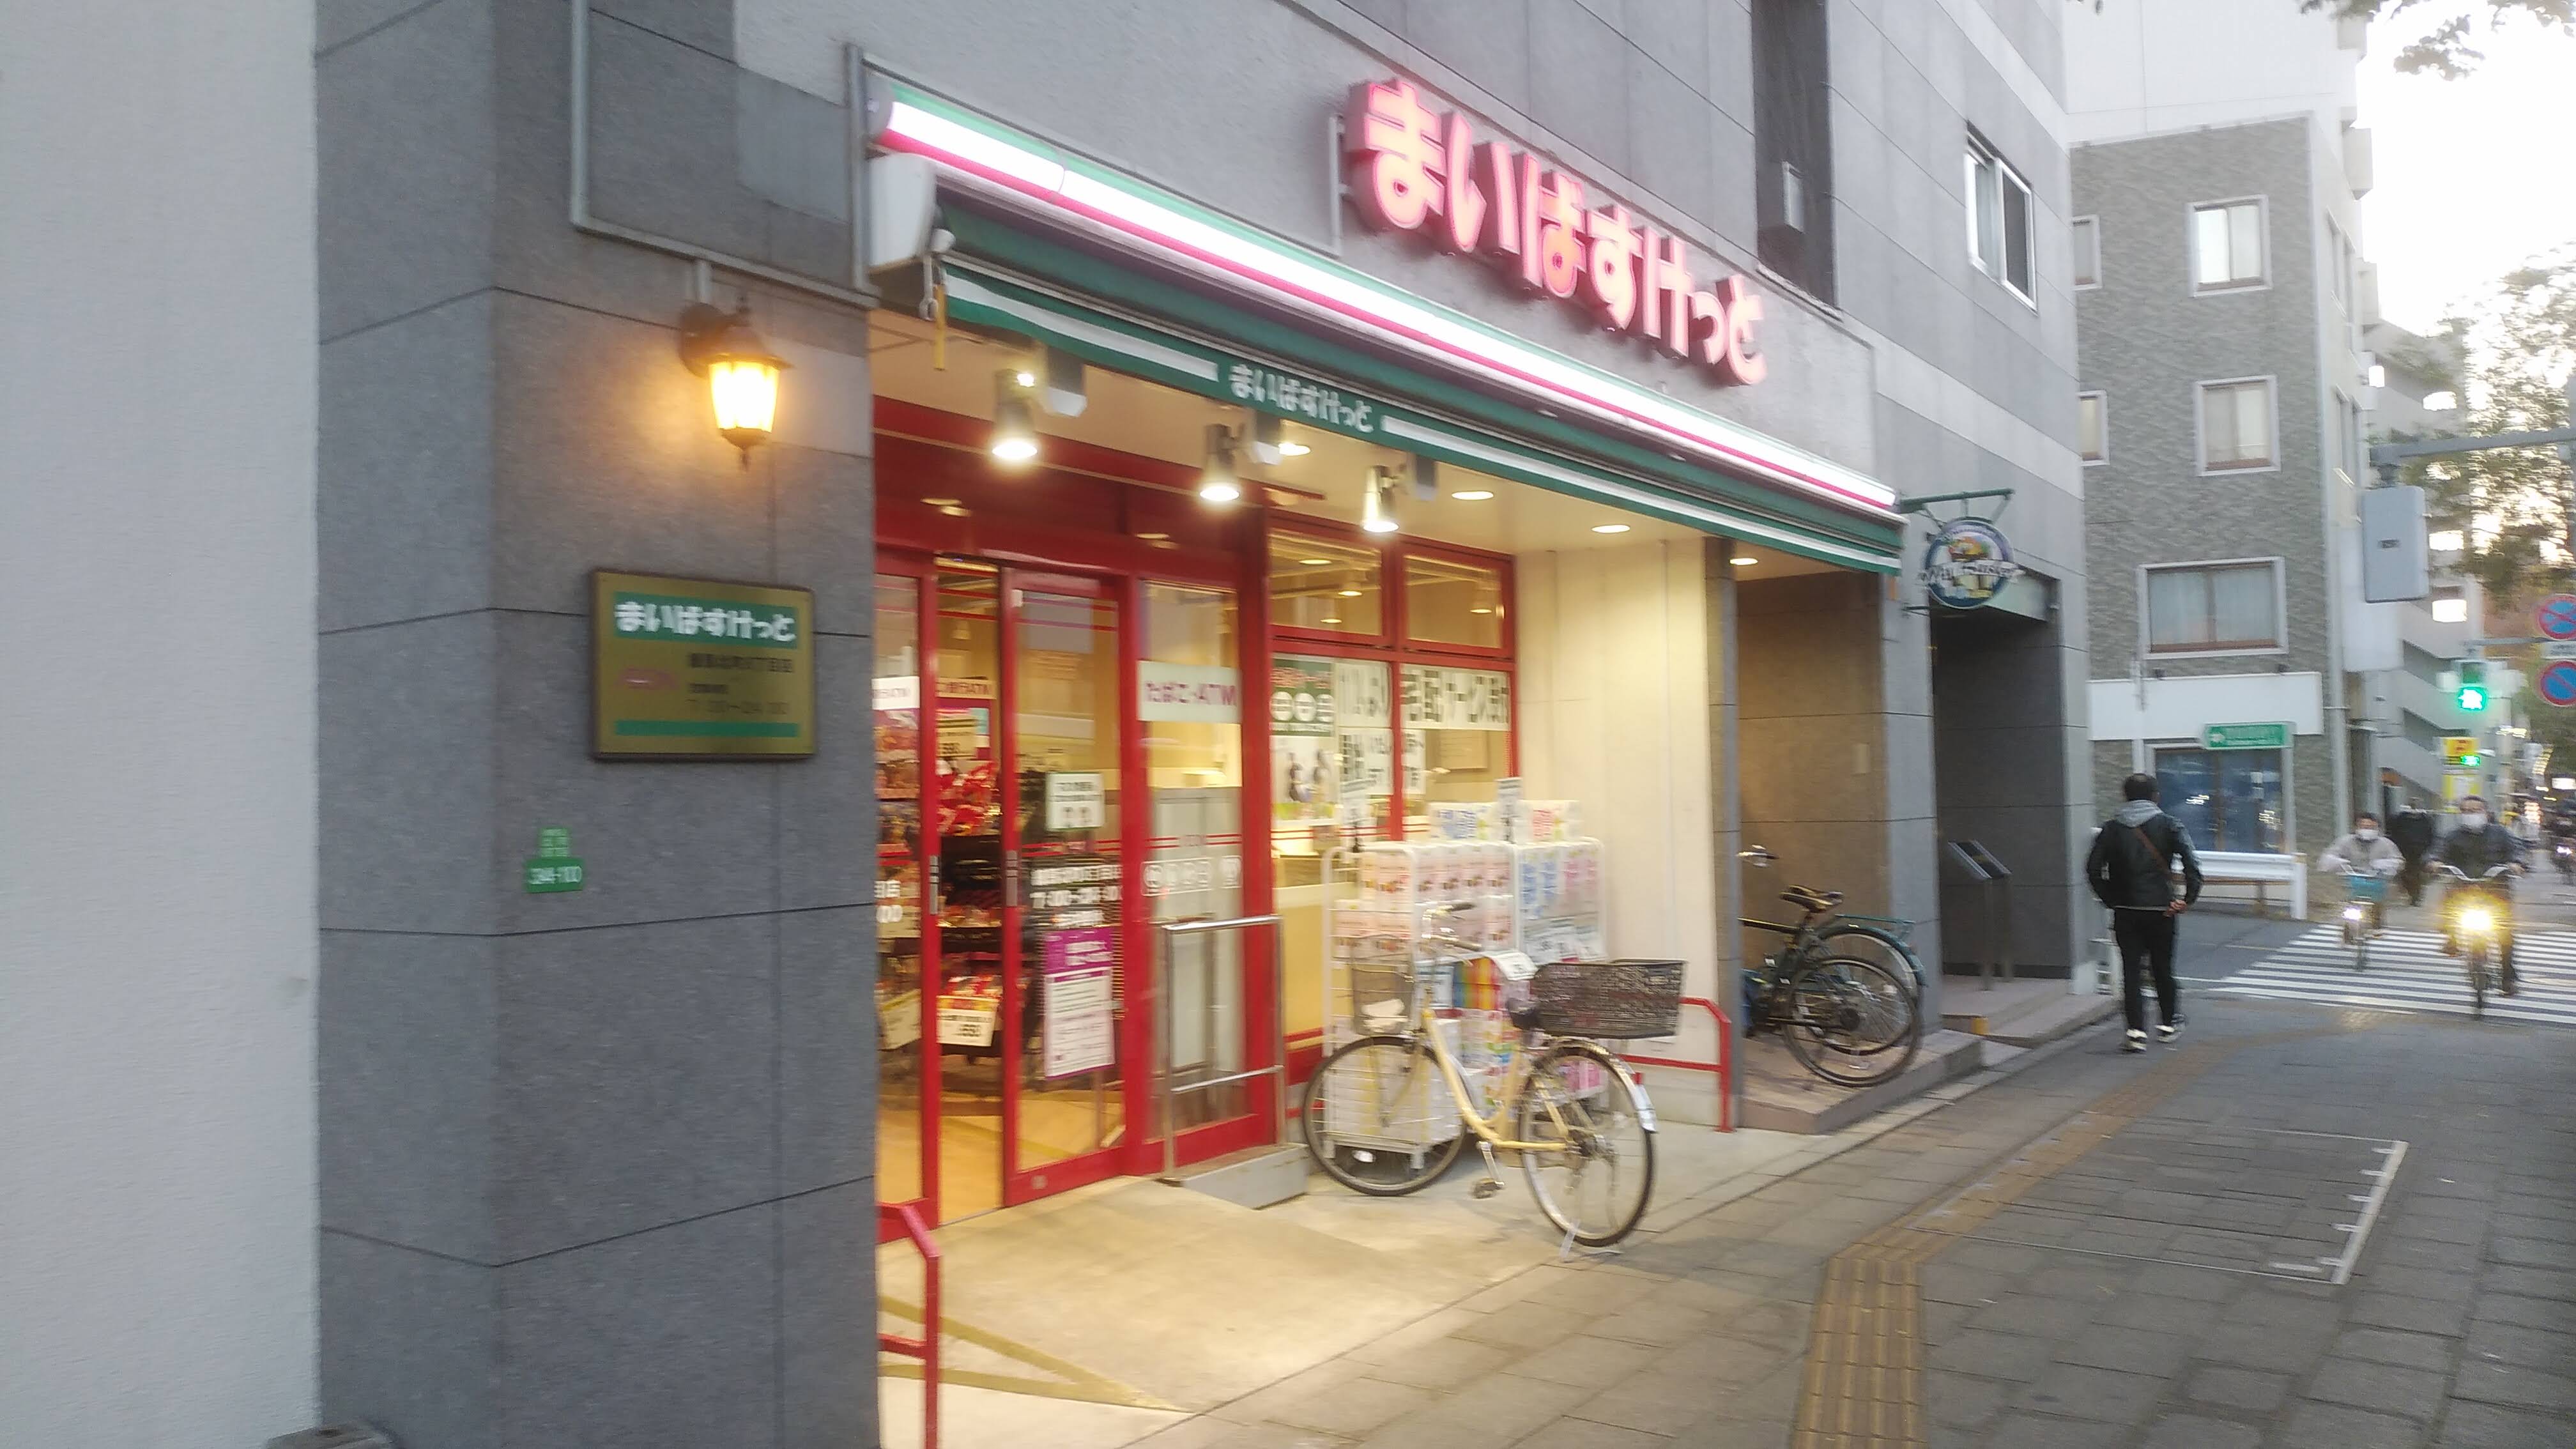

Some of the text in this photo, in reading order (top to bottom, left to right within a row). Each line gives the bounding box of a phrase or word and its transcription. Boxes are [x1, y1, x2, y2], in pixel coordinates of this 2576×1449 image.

[1360, 77, 1768, 386] まいばすけっと
[1228, 364, 1374, 433] まいばすけっと
[614, 601, 797, 642] まいばすけっと
